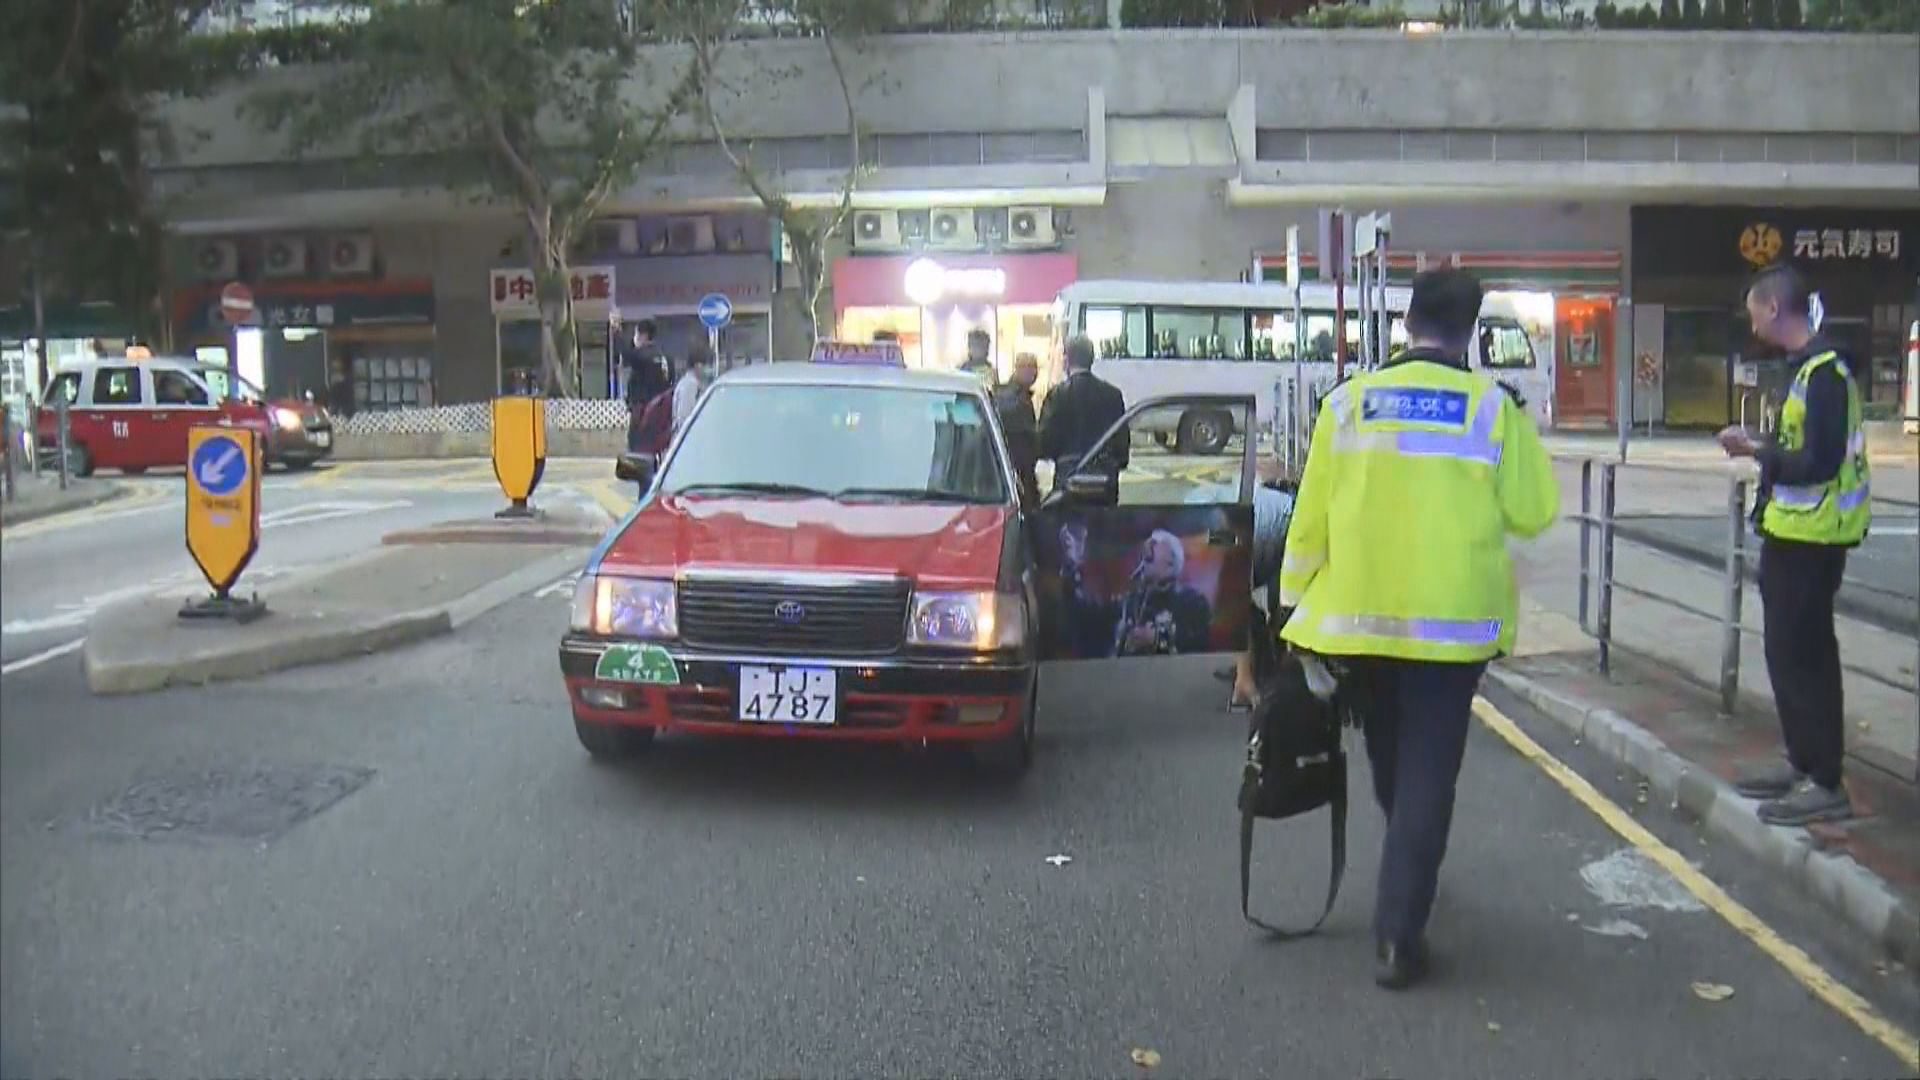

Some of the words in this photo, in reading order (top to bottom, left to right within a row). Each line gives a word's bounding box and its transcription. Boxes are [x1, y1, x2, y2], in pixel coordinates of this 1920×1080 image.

[628, 650, 643, 668] 4
[768, 666, 808, 694] TJ
[745, 694, 830, 719] 4787
